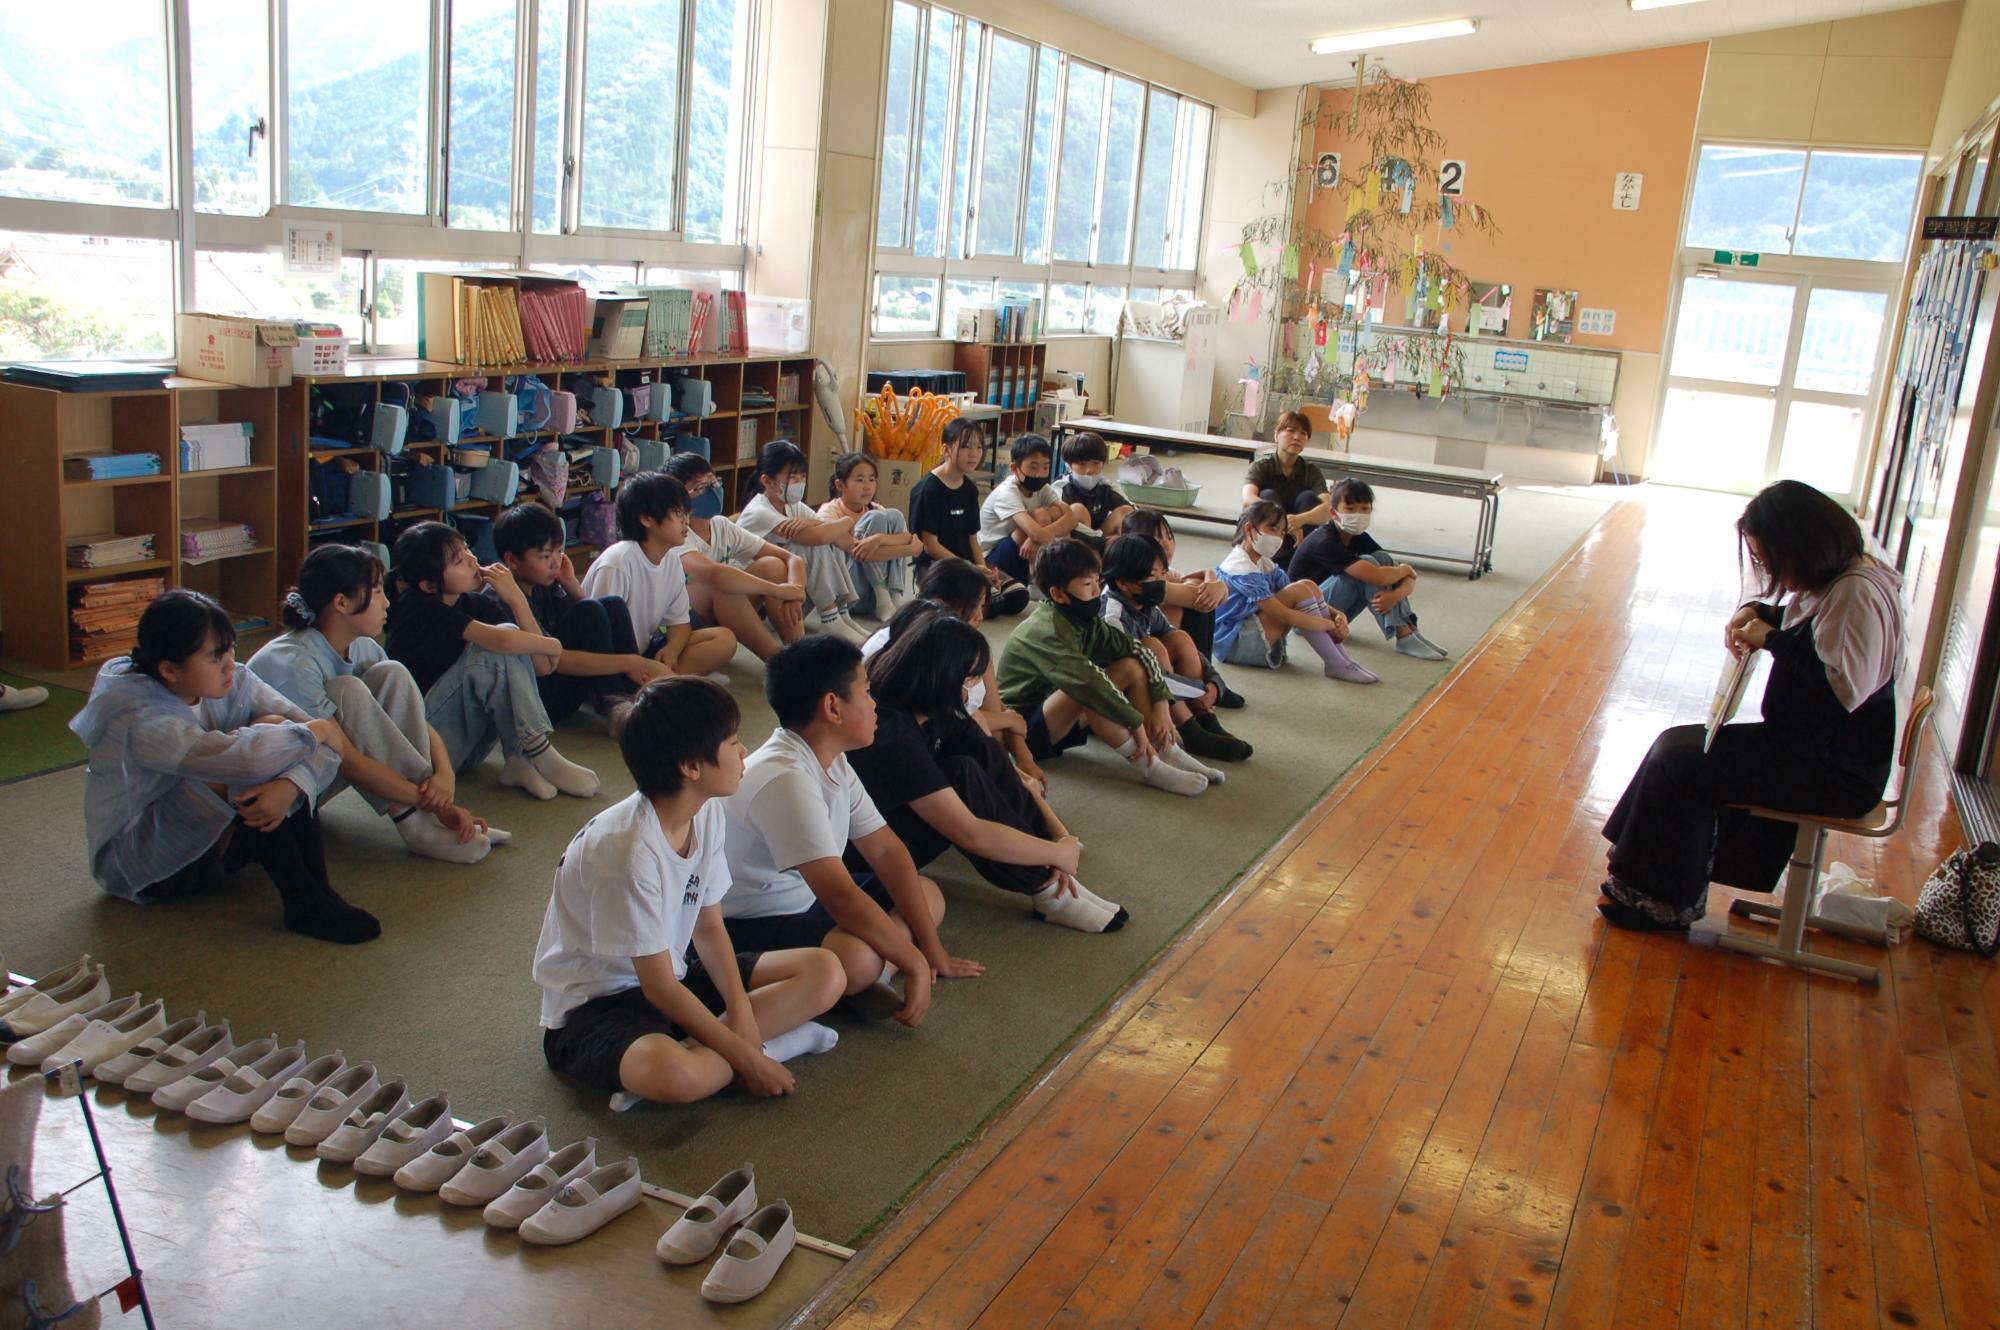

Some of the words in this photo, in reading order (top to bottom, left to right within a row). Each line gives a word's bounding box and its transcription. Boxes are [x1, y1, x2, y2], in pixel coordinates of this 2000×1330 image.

[1317, 154, 1338, 186] 6
[1441, 162, 1462, 194] 2
[1620, 174, 1635, 208] なかよし
